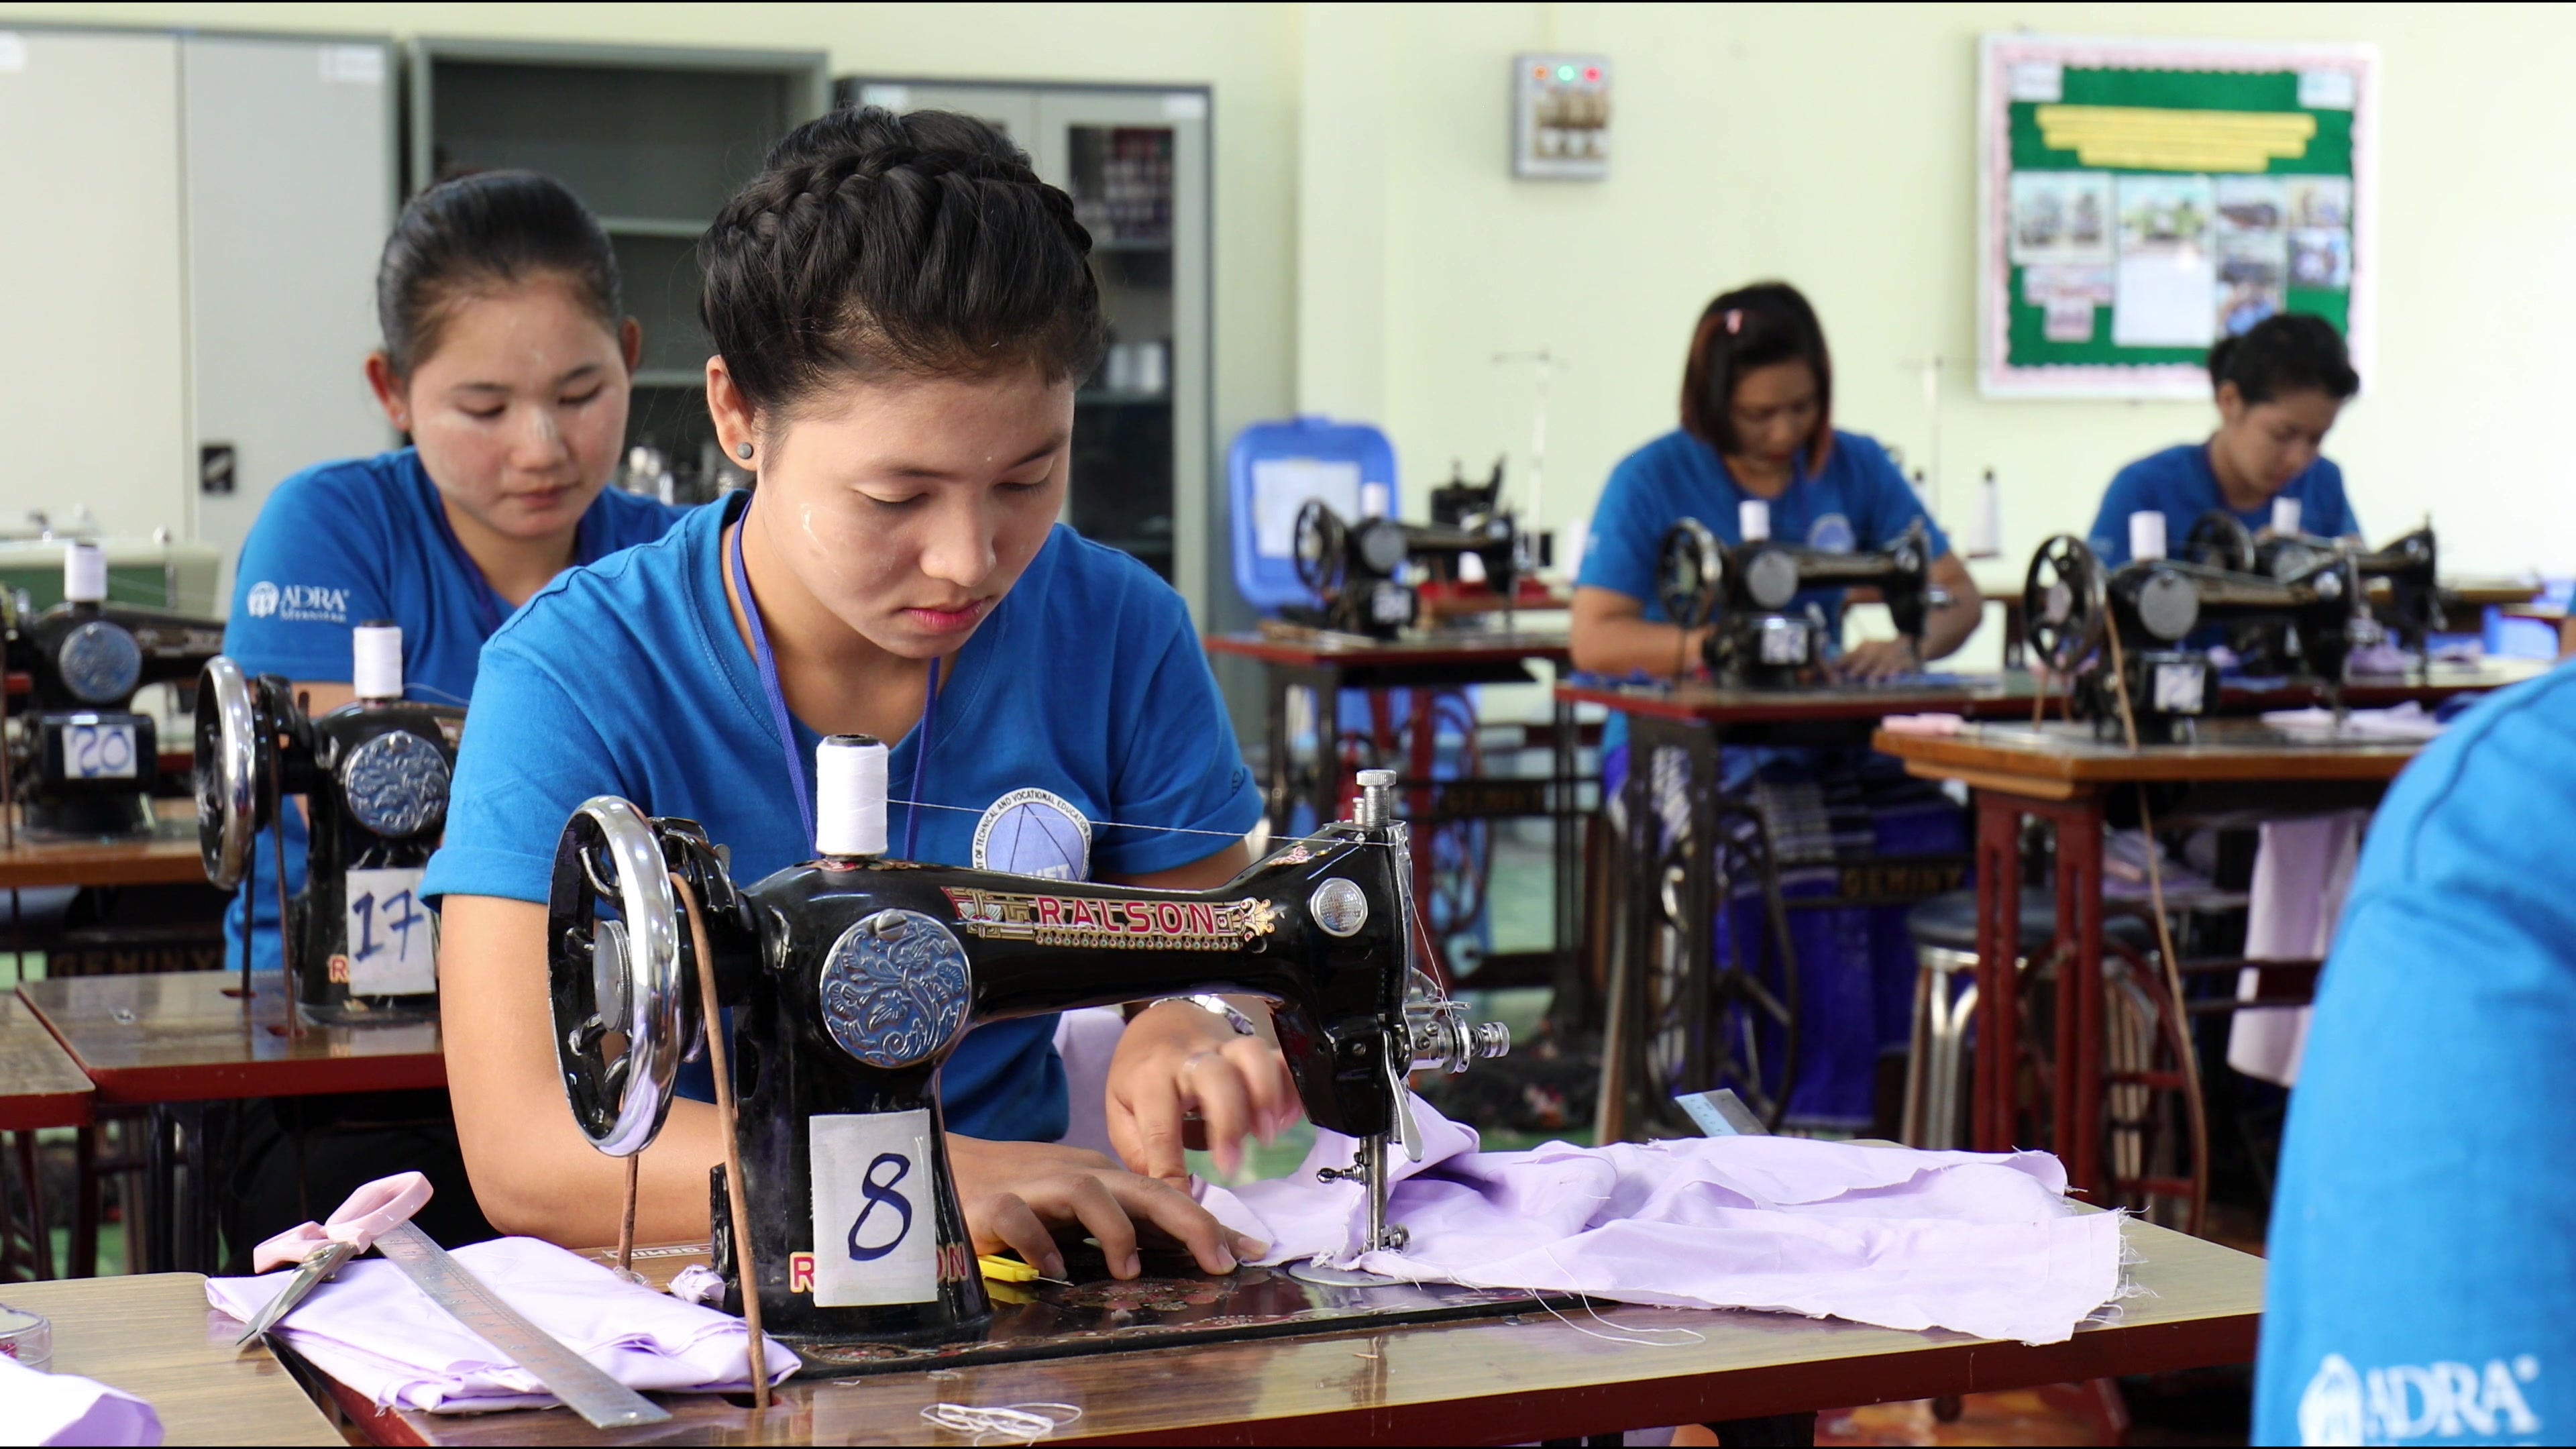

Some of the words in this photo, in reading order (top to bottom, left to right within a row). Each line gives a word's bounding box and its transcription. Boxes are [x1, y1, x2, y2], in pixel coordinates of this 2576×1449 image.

[280, 585, 347, 612] ADRA
[70, 725, 131, 777] 20
[997, 797, 1012, 810] AND
[1012, 790, 1055, 804] VOCATIONAL
[975, 808, 998, 846] TECHNICAL
[1057, 800, 1089, 833] EDUCATION
[975, 849, 983, 859] OF
[353, 889, 425, 962] 17
[1035, 896, 1219, 936] RALSON
[848, 1152, 912, 1261] 8
[2364, 1360, 2542, 1437] ADRA
